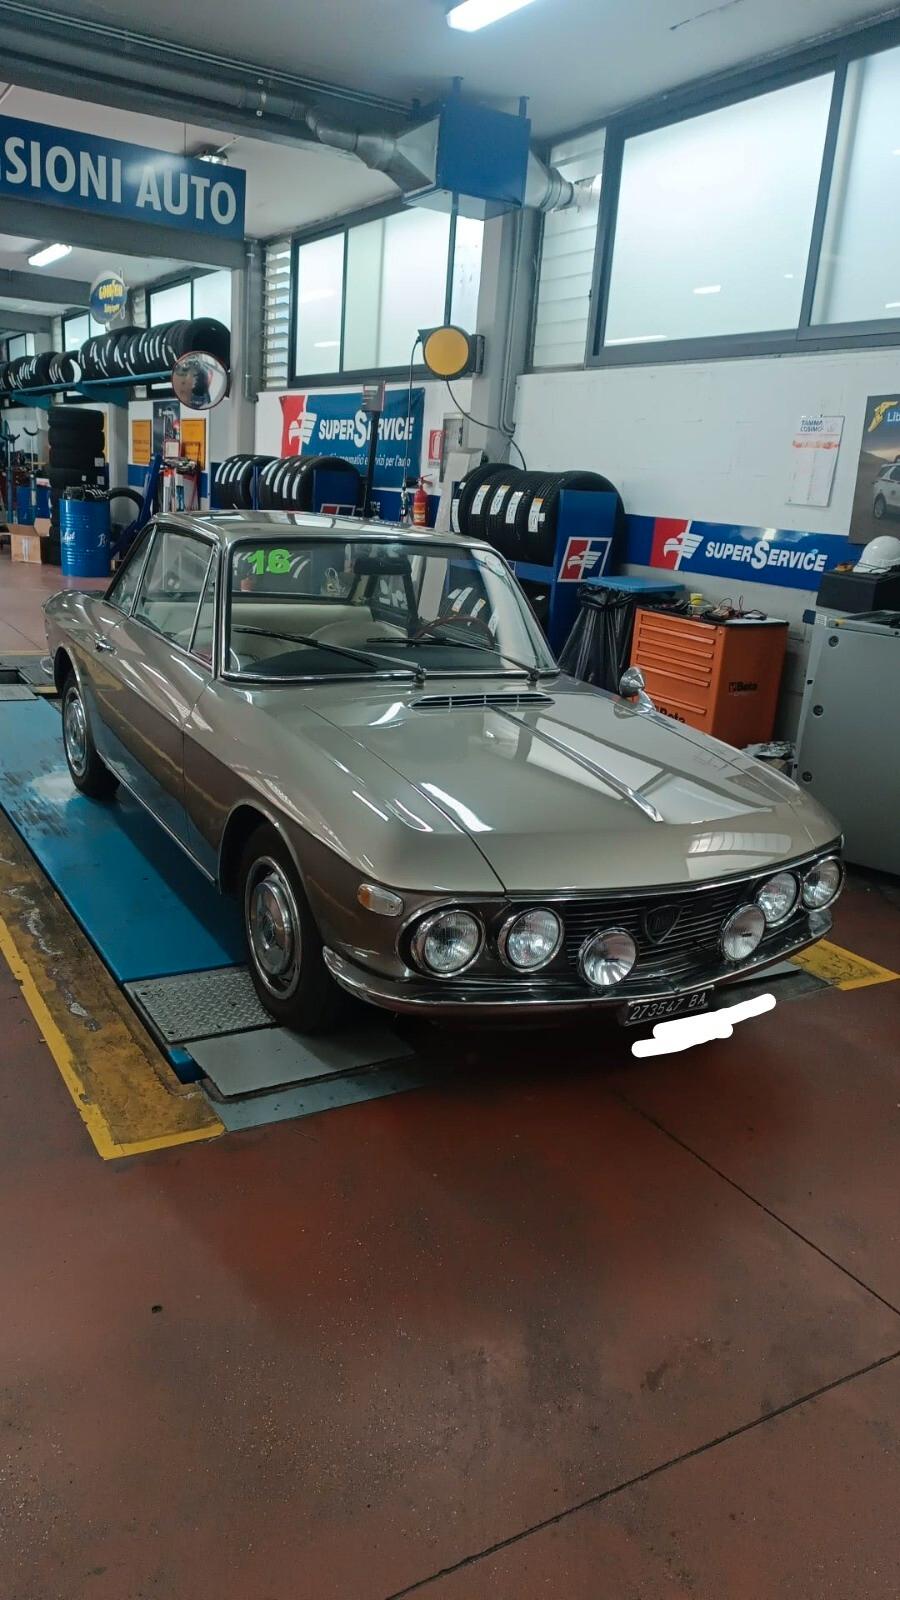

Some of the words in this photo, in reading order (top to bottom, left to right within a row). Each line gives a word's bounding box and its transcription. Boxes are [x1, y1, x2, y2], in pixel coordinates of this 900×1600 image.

[0, 136, 122, 203] SIONI
[136, 164, 237, 225] AUTO
[247, 548, 290, 575] 16
[629, 998, 685, 1020] 273547
[688, 992, 706, 1008] BA
